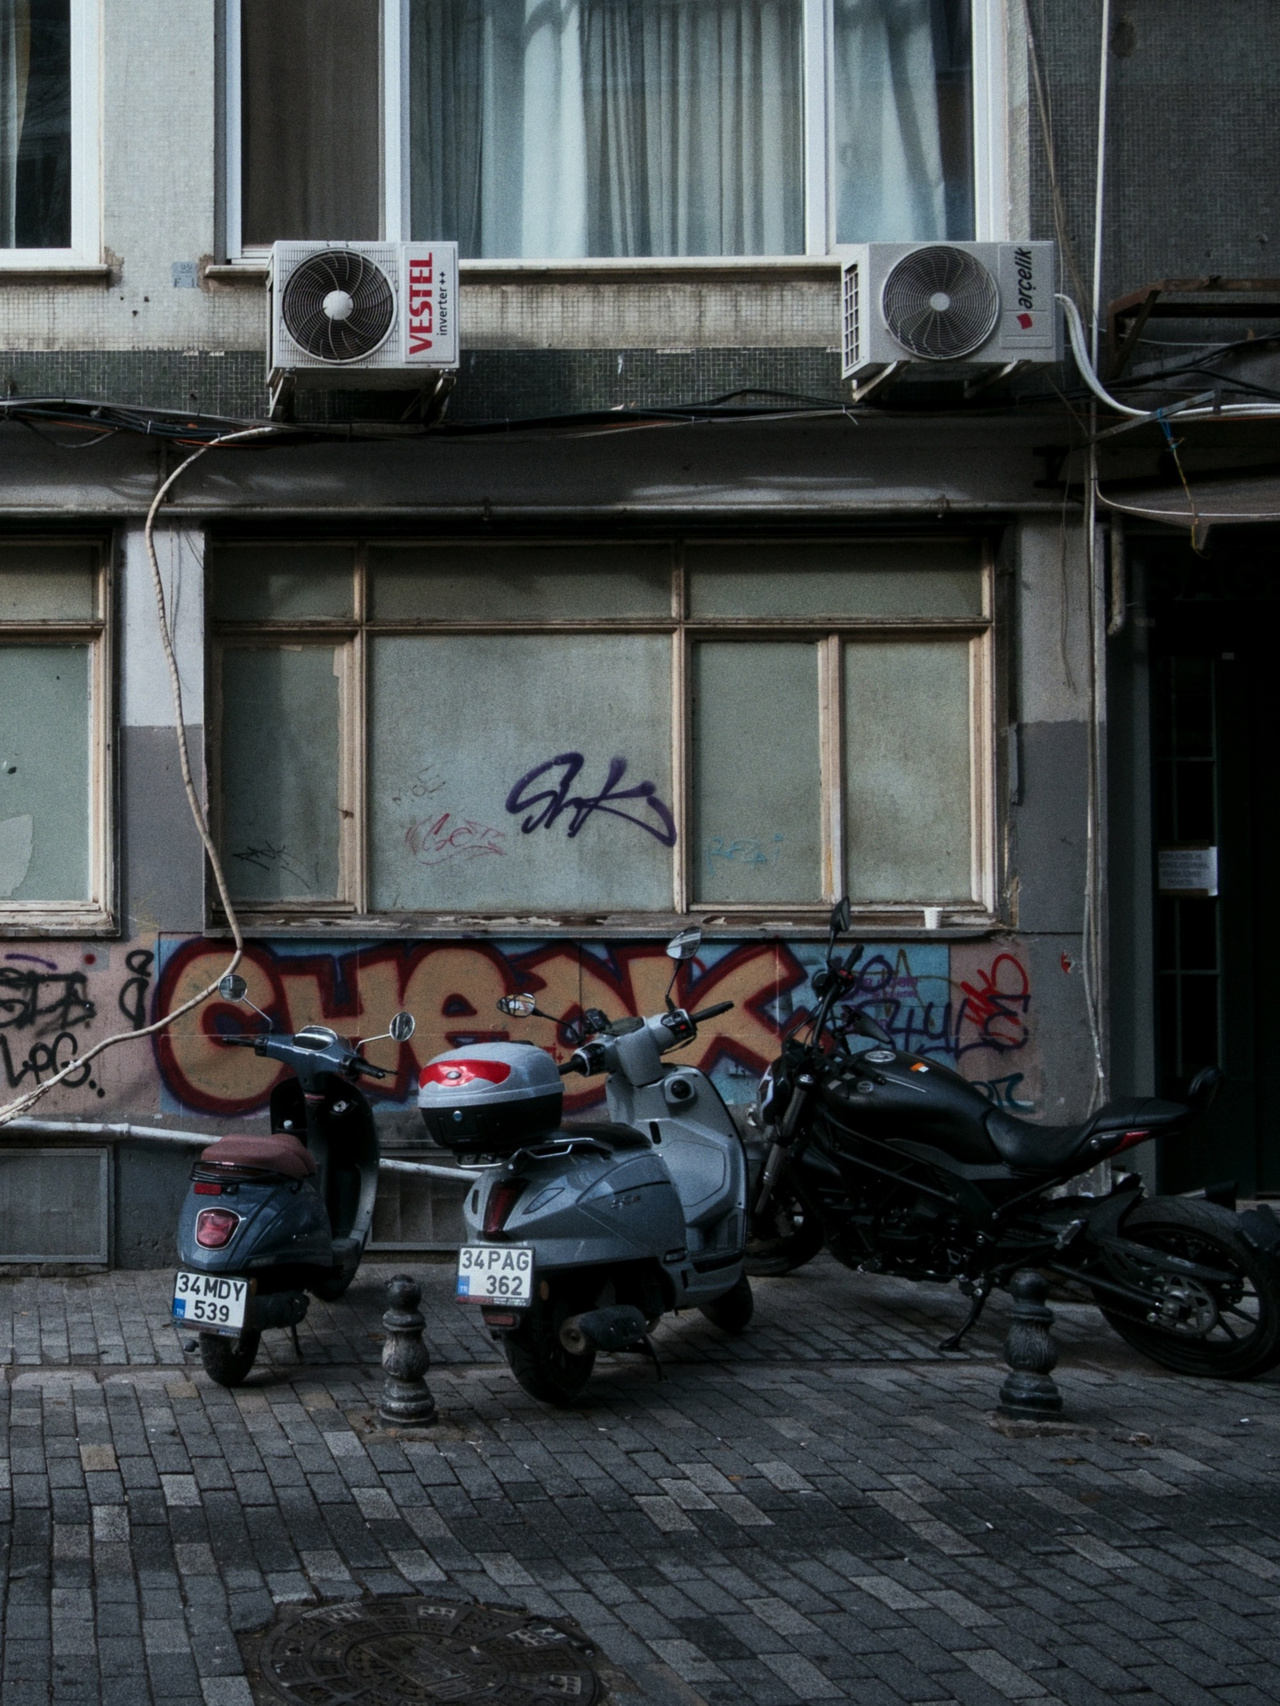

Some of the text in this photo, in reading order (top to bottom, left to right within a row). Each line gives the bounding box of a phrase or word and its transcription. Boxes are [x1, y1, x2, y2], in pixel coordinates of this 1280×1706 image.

[1014, 247, 1036, 310] arçelik
[408, 252, 433, 356] VESTEL
[486, 1274, 523, 1296] 362
[176, 1300, 230, 1322] TR 539
